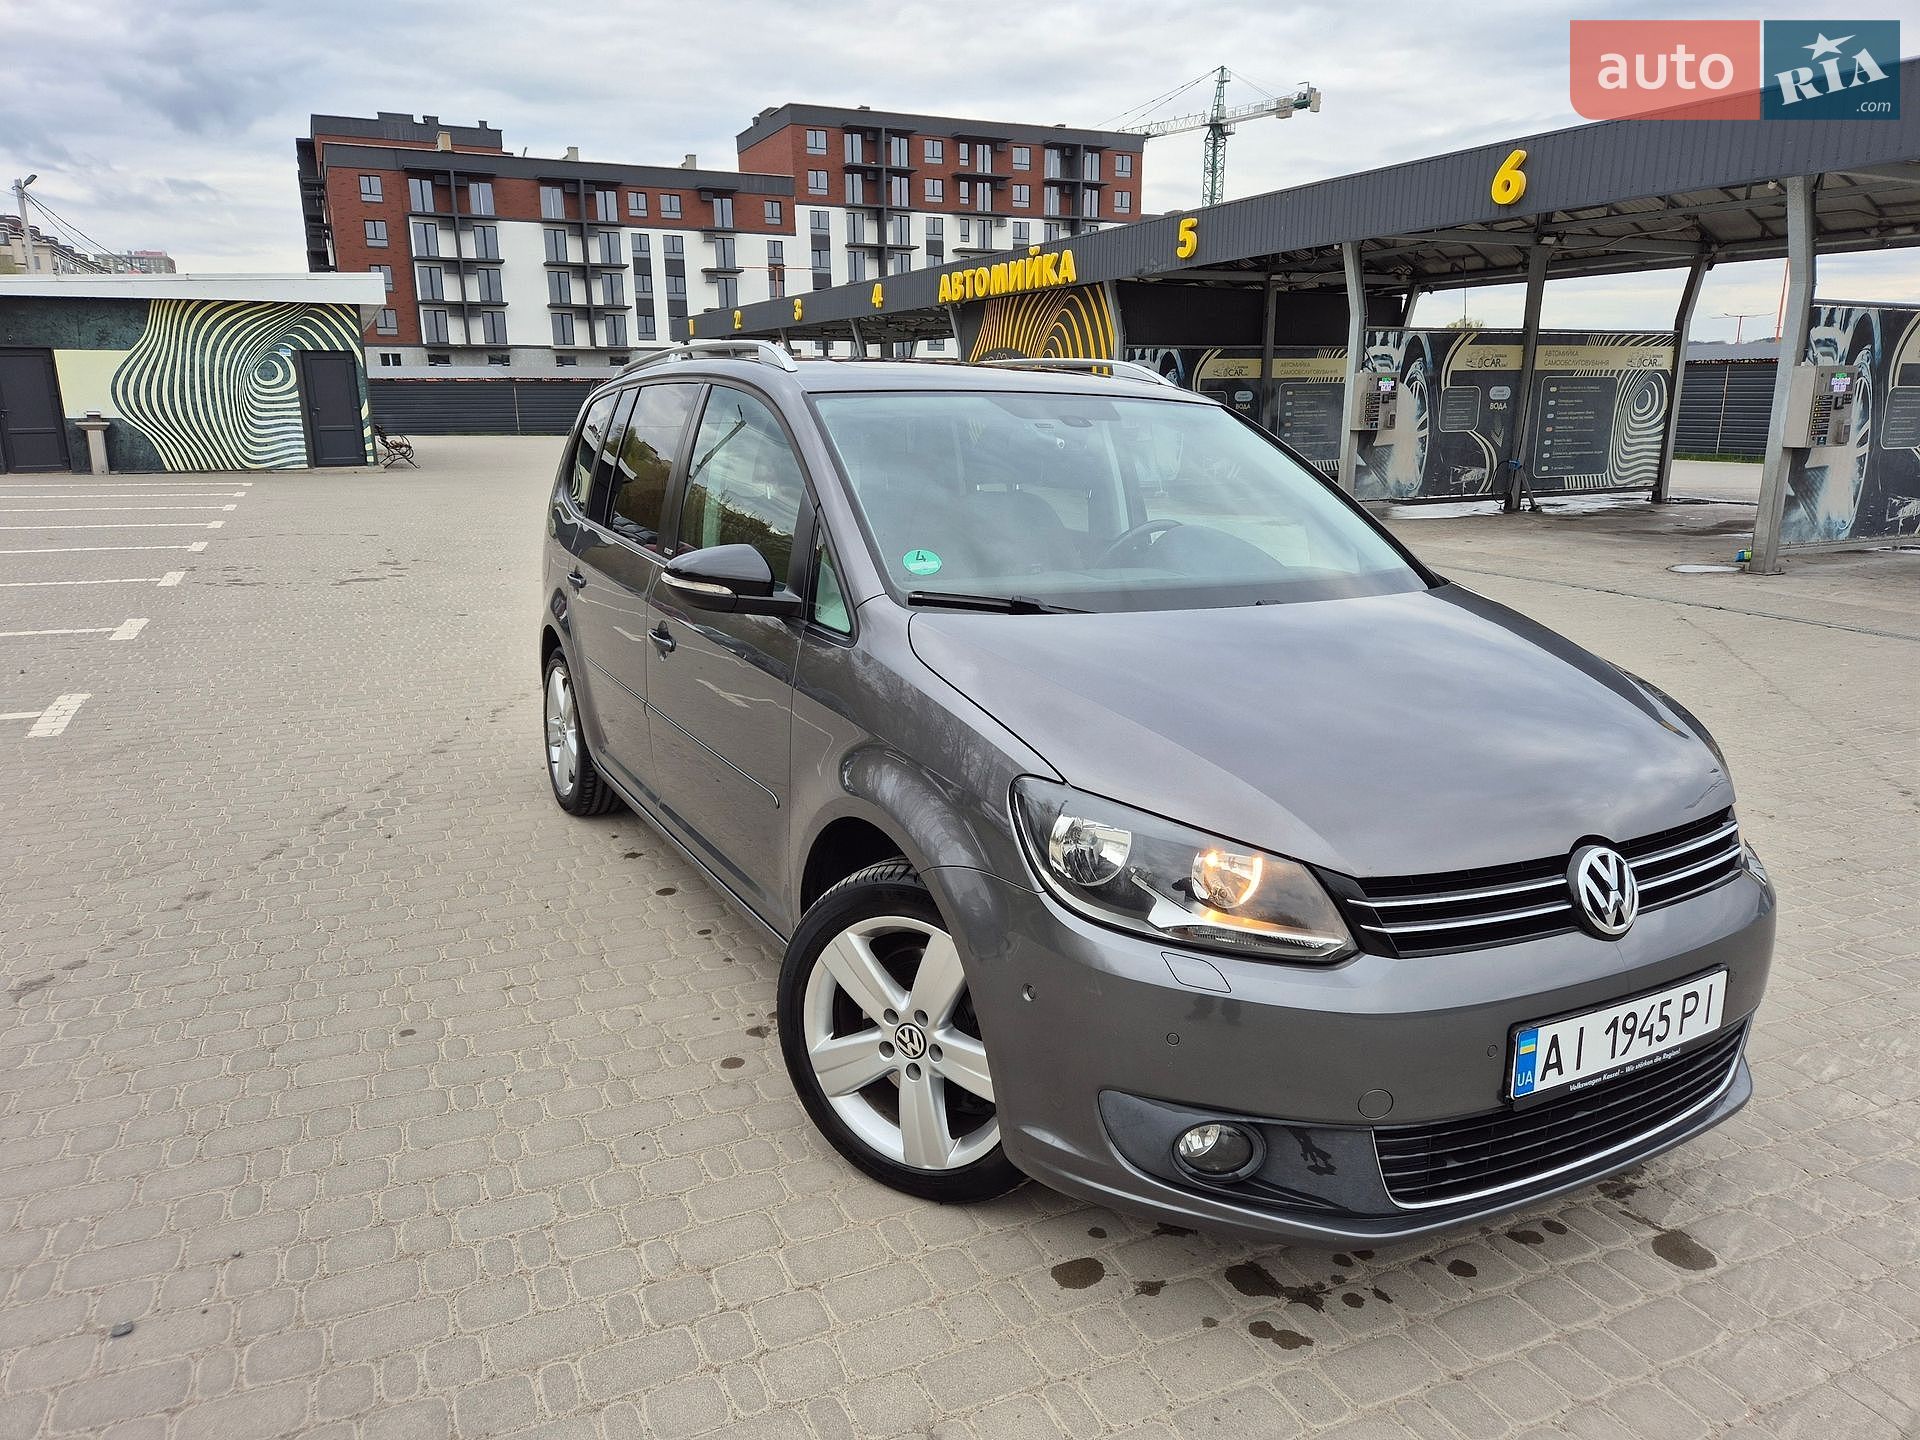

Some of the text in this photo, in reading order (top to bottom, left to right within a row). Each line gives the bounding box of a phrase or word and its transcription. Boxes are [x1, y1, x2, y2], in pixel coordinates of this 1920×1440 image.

[1491, 149, 1528, 206] 6
[1176, 217, 1198, 259] 5
[937, 245, 1078, 304] АВТОМИЙКА
[871, 283, 884, 308] 4
[793, 298, 803, 321] 3
[688, 319, 695, 336] 1
[733, 310, 742, 329] 2
[1235, 403, 1251, 411] ВОДА
[1489, 402, 1508, 411] ВОДА
[915, 550, 927, 562] 4
[1540, 1026, 1584, 1082] AI
[1604, 999, 1672, 1060] 1945
[1517, 1070, 1533, 1087] UA
[1569, 1077, 1602, 1092] Volkswagen
